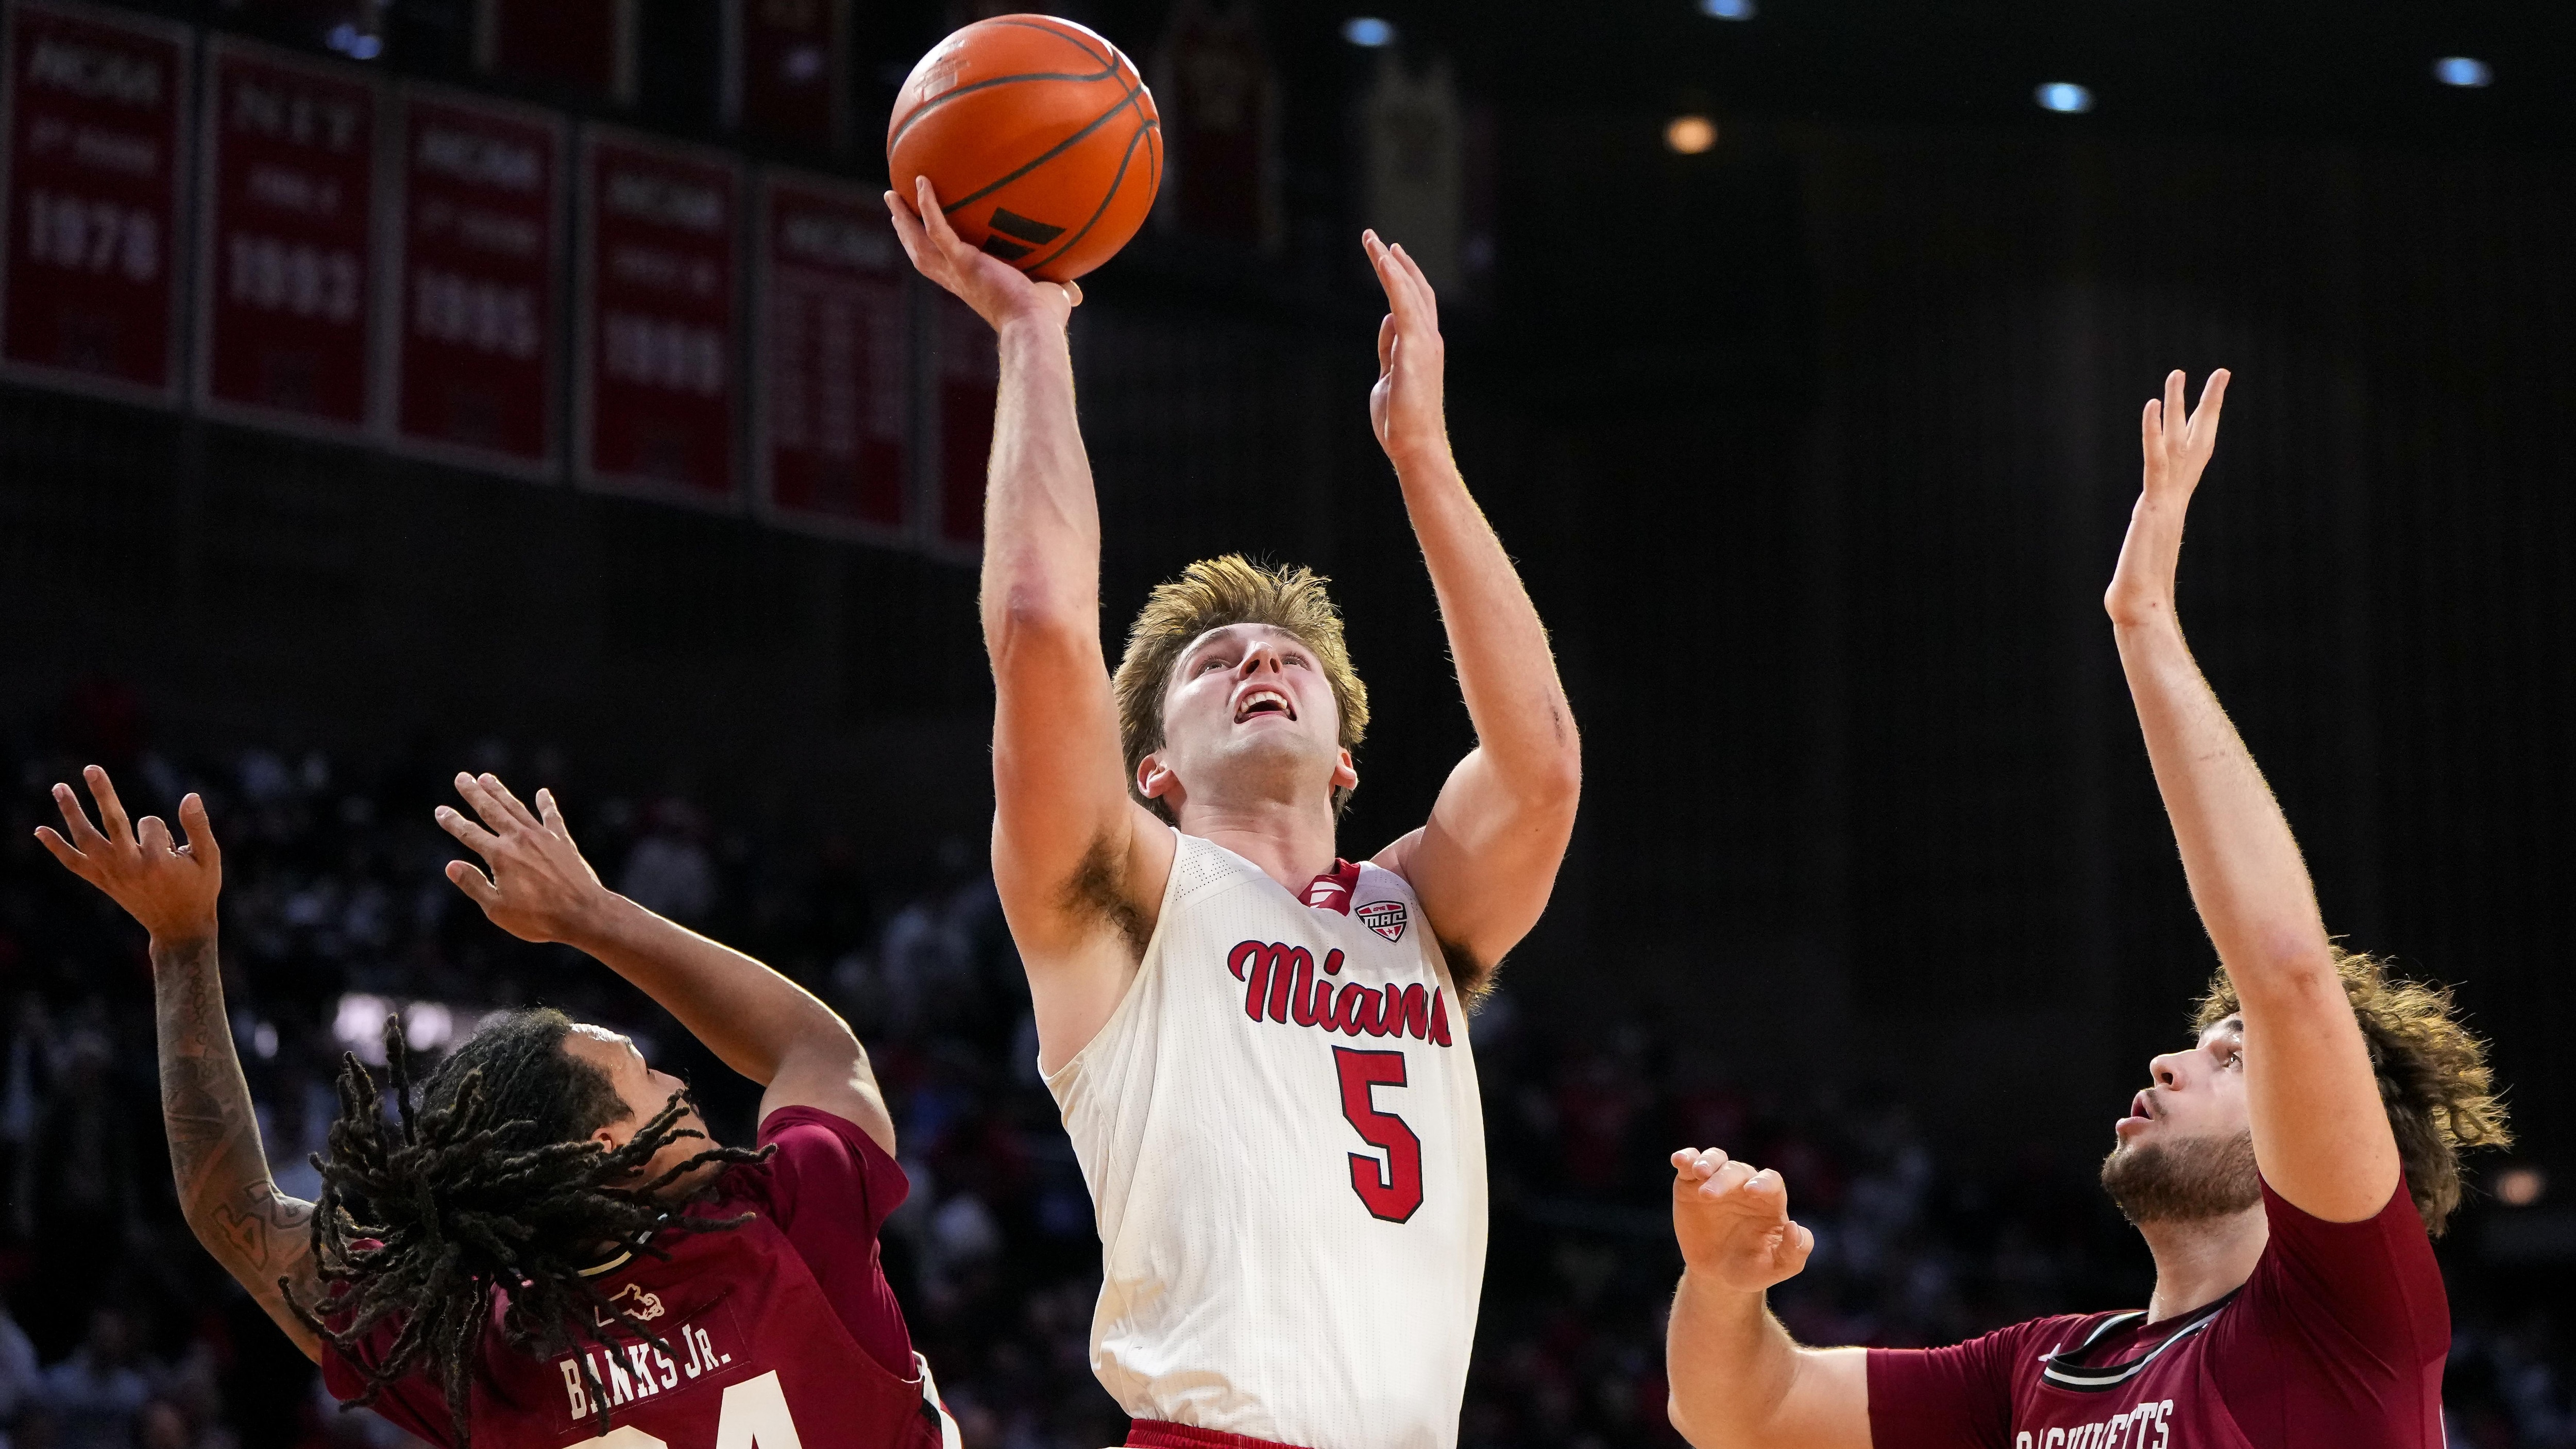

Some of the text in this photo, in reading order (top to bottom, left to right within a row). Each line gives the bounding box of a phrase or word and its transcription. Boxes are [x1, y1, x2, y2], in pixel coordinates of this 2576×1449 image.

[1363, 912, 1407, 928] MAC
[1227, 939, 1452, 1048] Miam
[1331, 1044, 1423, 1224] 5
